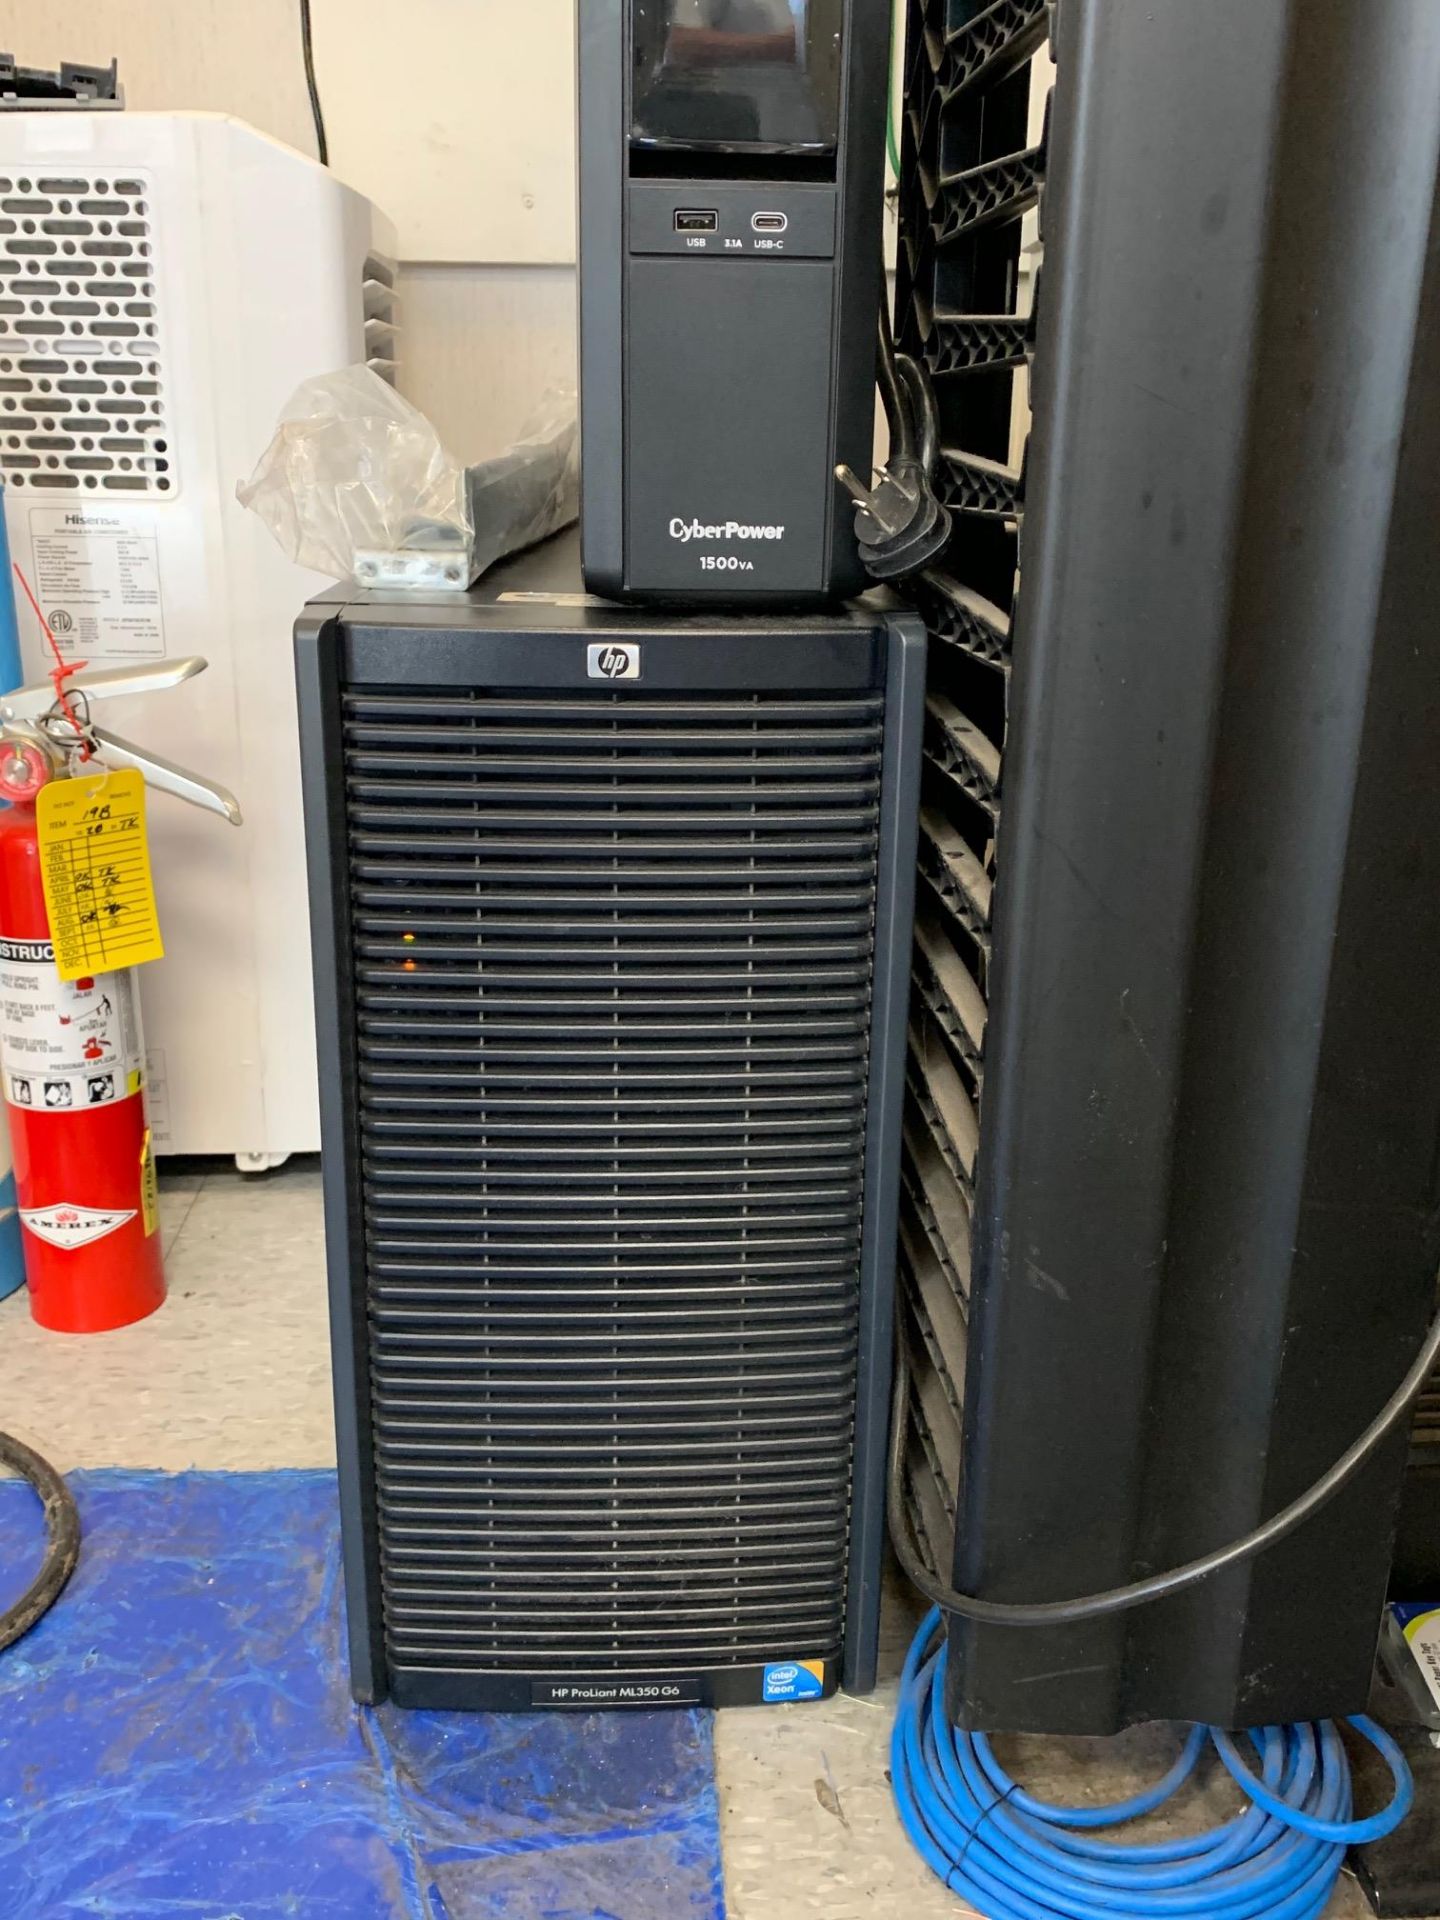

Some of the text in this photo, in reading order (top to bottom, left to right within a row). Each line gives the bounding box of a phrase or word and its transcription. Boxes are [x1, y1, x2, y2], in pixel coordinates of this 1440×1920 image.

[686, 238, 706, 247] USB
[724, 238, 743, 248] 3.1A
[754, 240, 784, 249] USB-C
[65, 514, 120, 525] Hisense
[669, 518, 784, 542] CyberPower
[602, 647, 627, 678] hp
[0, 942, 54, 960] STRUC
[30, 1218, 113, 1229] AMEREX
[771, 1669, 793, 1680] intel
[552, 1686, 680, 1698] HP ProLiant ML350 G6
[767, 1685, 795, 1695] Xeon
